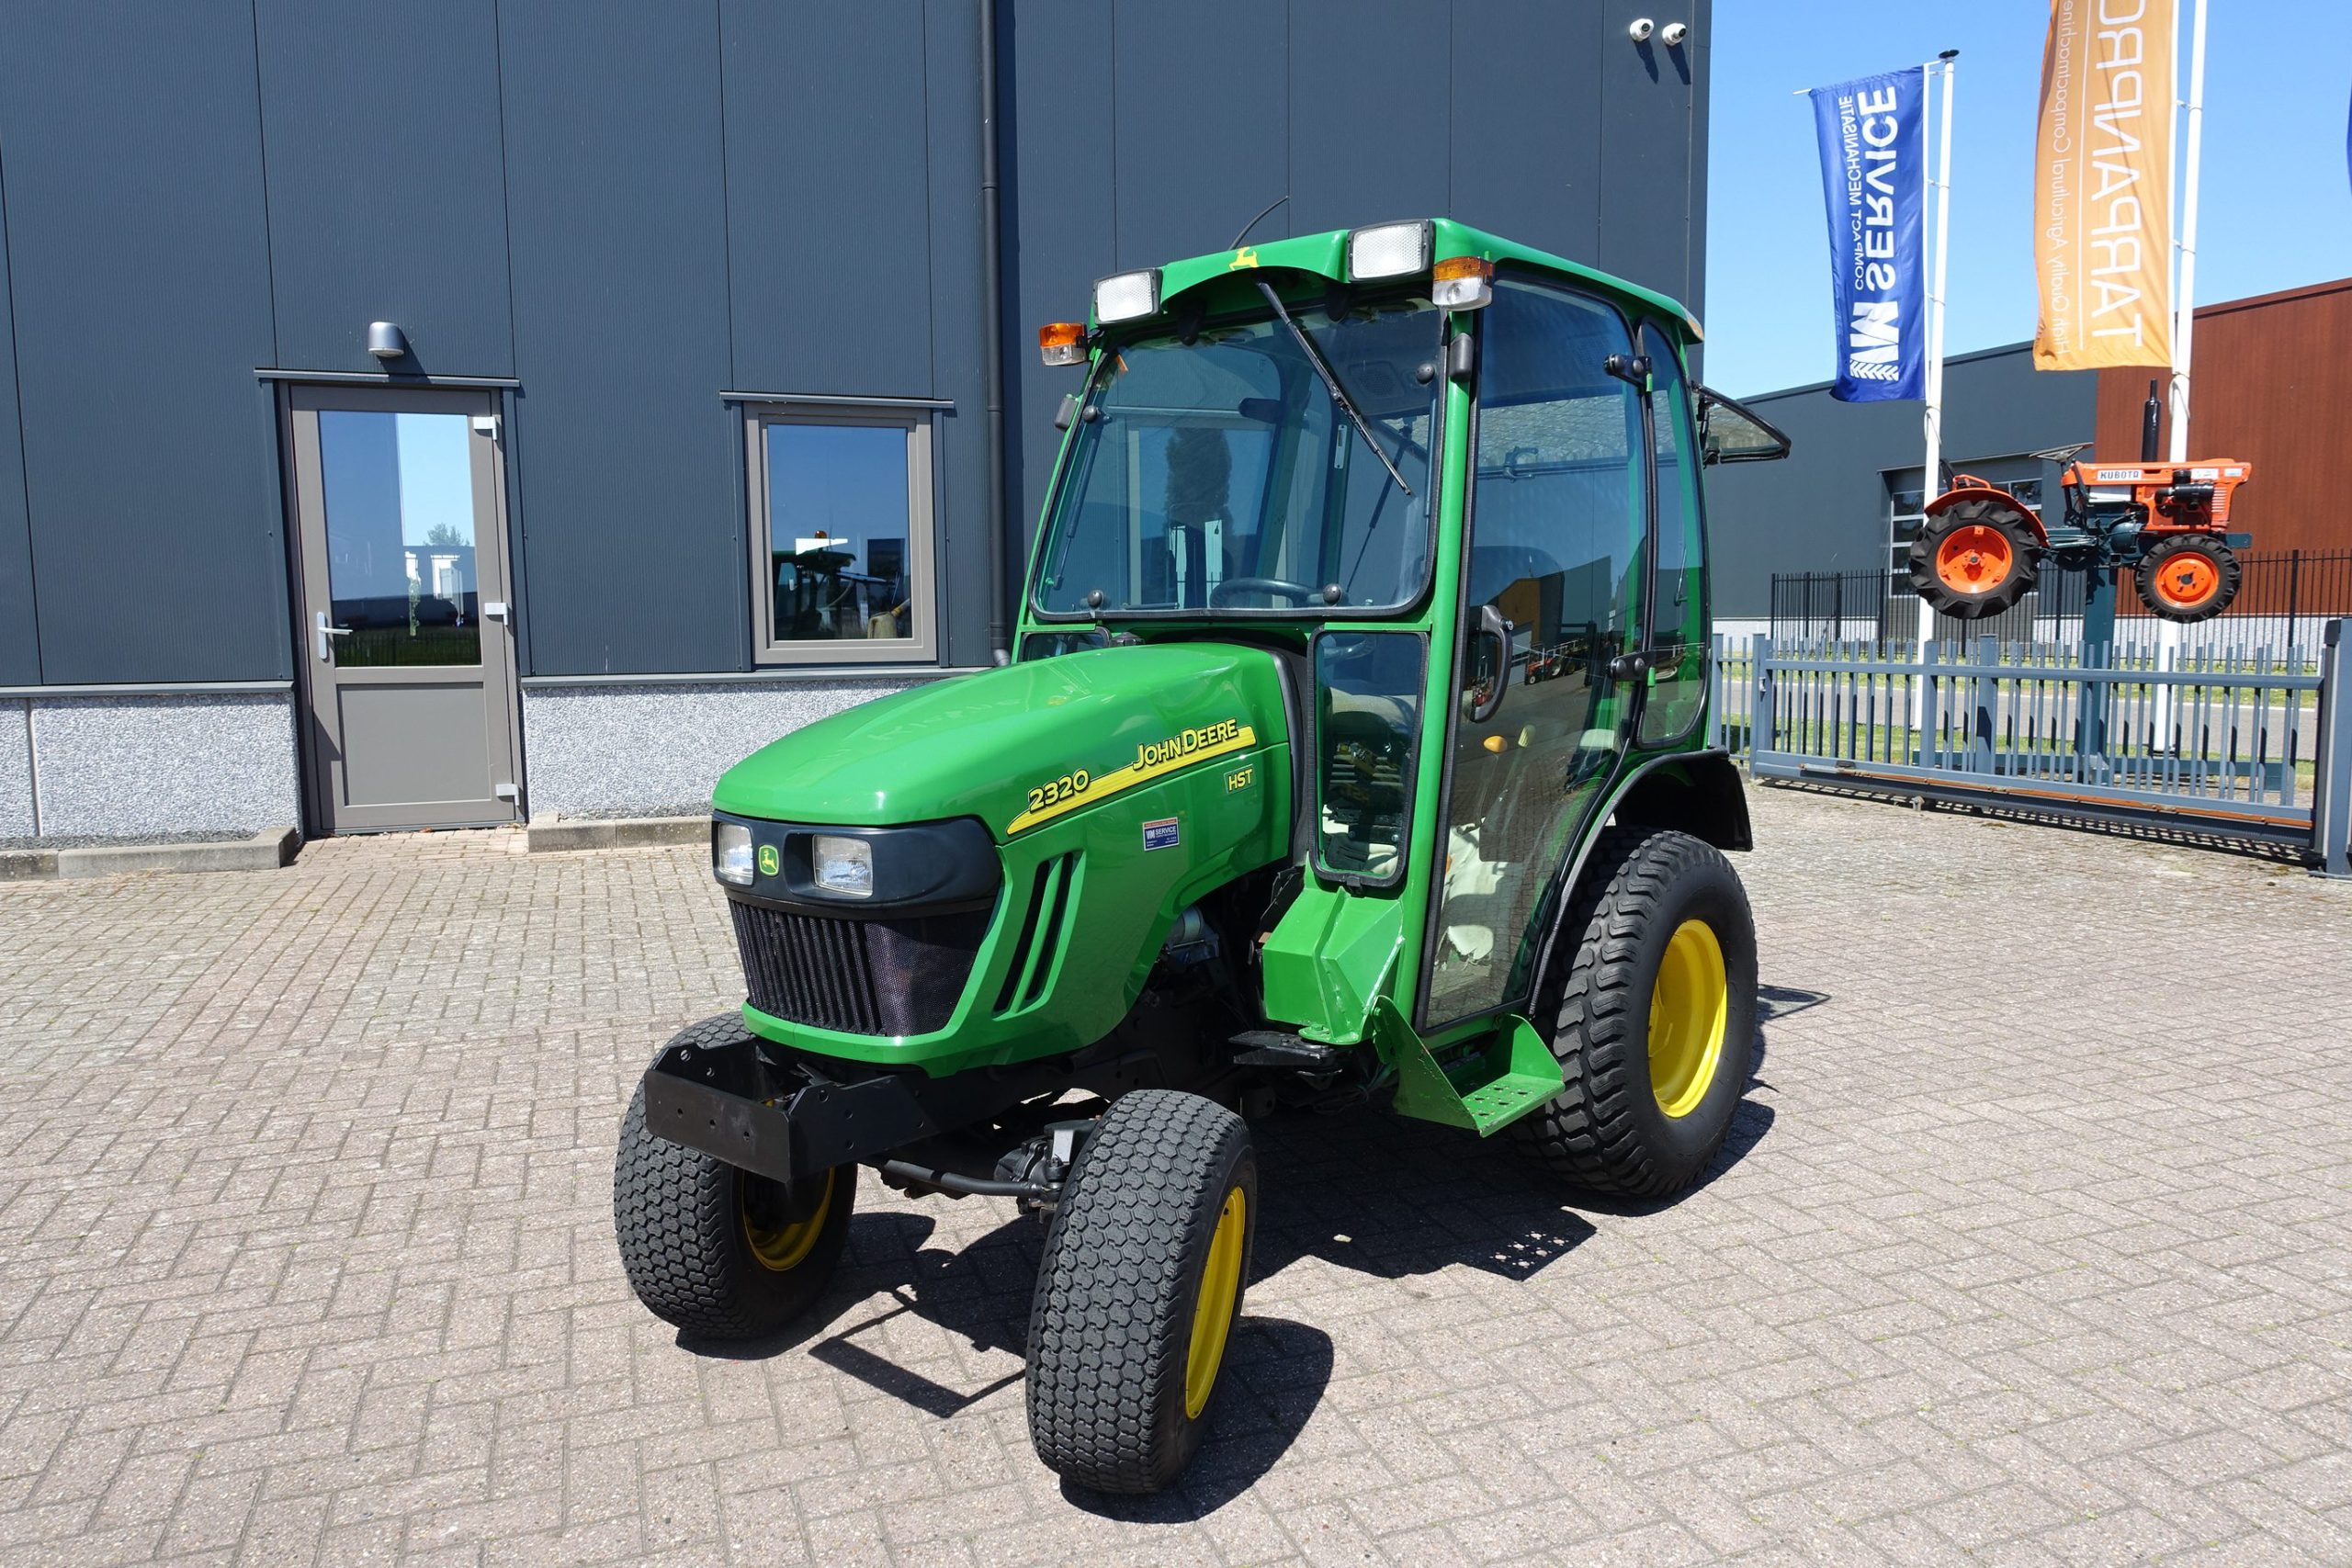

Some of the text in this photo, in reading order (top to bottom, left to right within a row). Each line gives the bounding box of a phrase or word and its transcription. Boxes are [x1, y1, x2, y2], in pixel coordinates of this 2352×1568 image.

[2099, 469, 2140, 480] KUBOTA
[1133, 717, 1239, 773] JOHN DEERE
[1028, 770, 1090, 814] 2320
[1228, 768, 1253, 792] HST
[1155, 826, 1177, 835] SERVICE
